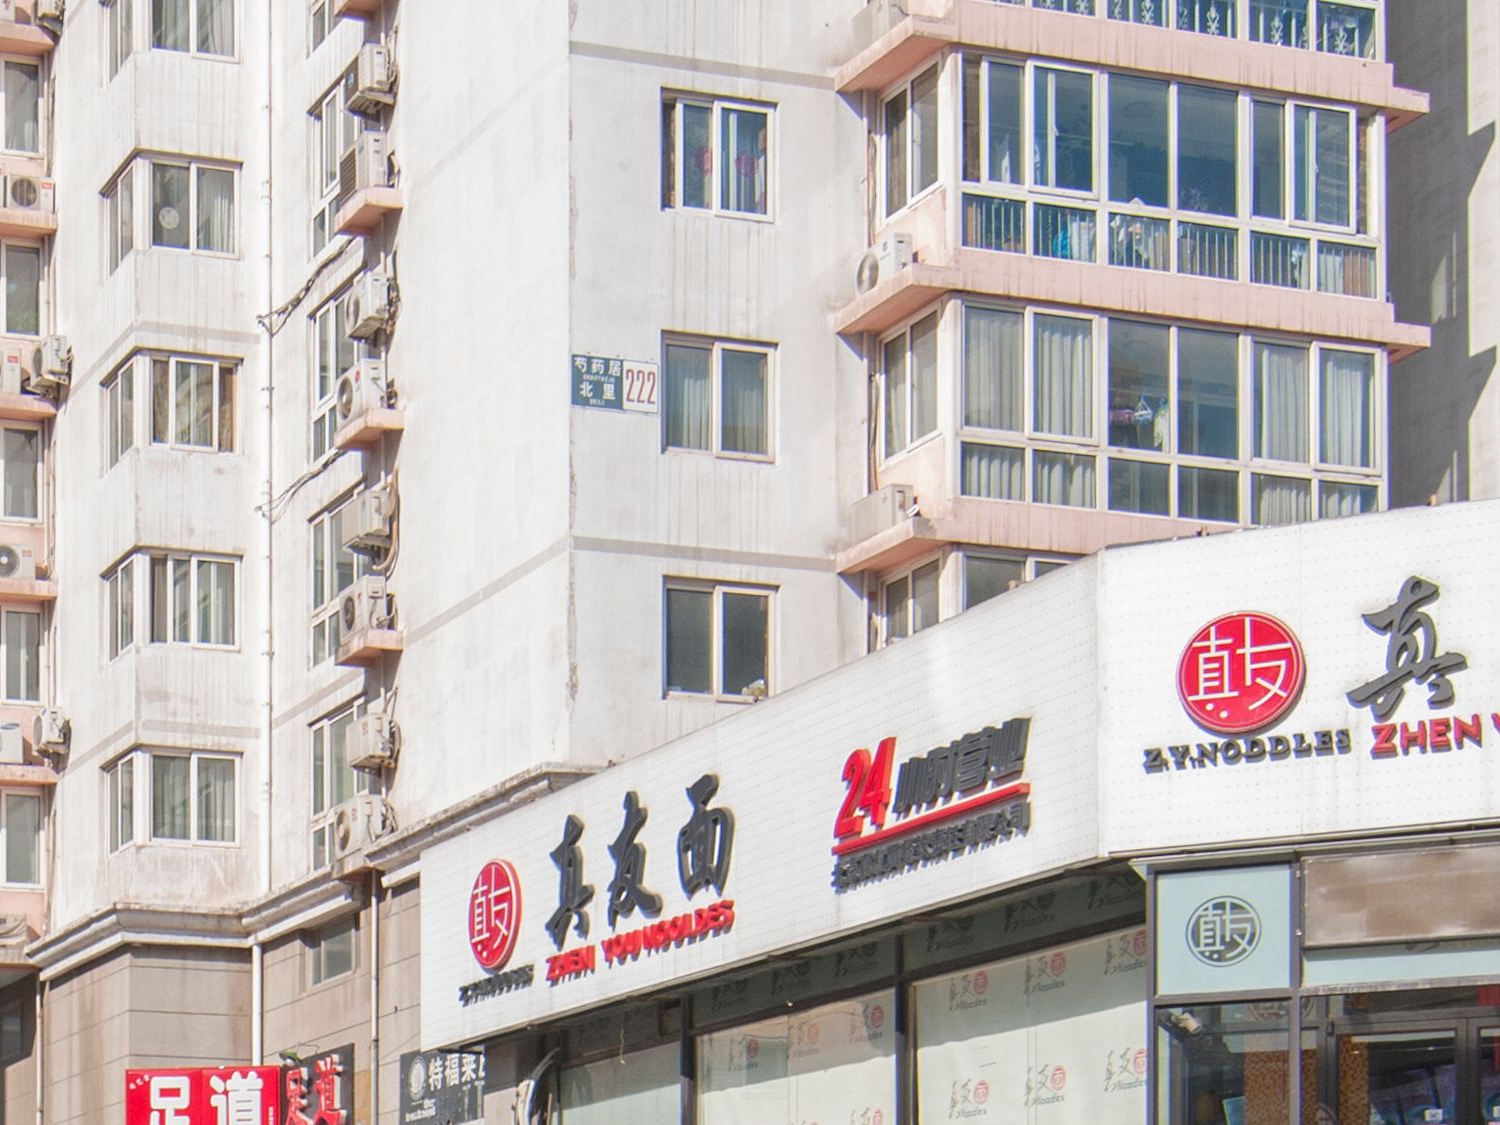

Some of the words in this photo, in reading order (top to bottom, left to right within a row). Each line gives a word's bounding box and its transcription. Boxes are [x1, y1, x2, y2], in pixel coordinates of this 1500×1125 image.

[579, 381, 616, 400] 北里
[625, 368, 657, 405] 222
[1369, 713, 1483, 760] ZHEN
